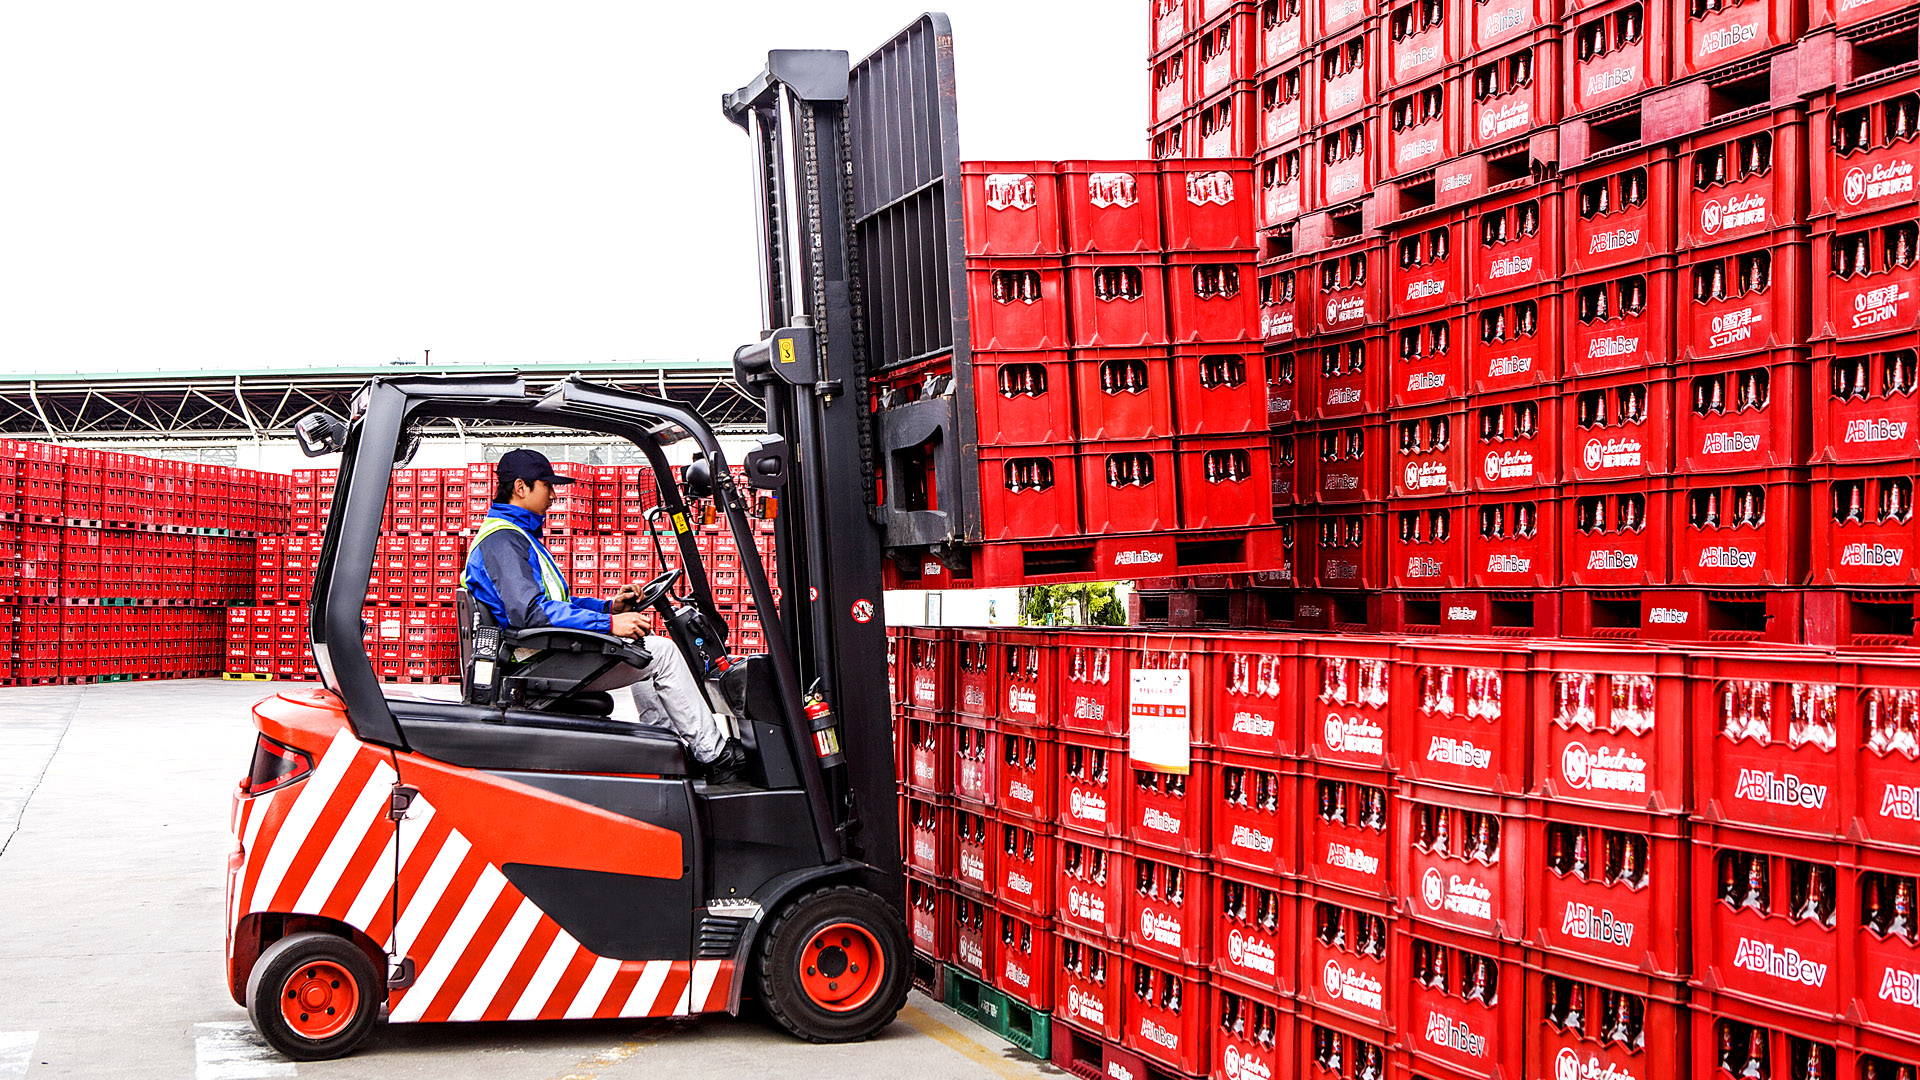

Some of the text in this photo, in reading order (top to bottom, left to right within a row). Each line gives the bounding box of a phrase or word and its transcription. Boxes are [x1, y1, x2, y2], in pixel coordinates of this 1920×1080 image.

[1485, 7, 1525, 39] ABInBev
[1700, 22, 1758, 57] ABInBev
[1399, 45, 1438, 73] ABInBev
[1586, 65, 1635, 96] ABInBev
[1496, 101, 1529, 121] Sedrin
[1399, 139, 1437, 163] ABInBev
[1440, 173, 1472, 192] ABInBev
[1866, 160, 1913, 183] Sedrin
[1722, 193, 1766, 215] Sedrin
[1589, 229, 1639, 254] ABInBev
[1490, 256, 1533, 279] ABInBev
[1407, 279, 1445, 300] ABInBev
[1867, 284, 1898, 310] 雪津
[1338, 297, 1365, 312] Sedrin
[1852, 303, 1897, 329] SEDRIN
[1723, 307, 1752, 331] 雪津
[1588, 335, 1638, 358] ABInBev
[1709, 325, 1751, 349] SEDRIN
[1488, 356, 1532, 377] ABInBev
[1408, 372, 1445, 391] ABInBev
[1327, 388, 1361, 405] ABInBev
[1703, 431, 1760, 454] ABInBev
[1845, 418, 1907, 443] ABInBev
[1603, 437, 1641, 454] Sedrin
[1419, 462, 1447, 476] Sedrin
[1499, 453, 1533, 466] Sedrin
[1115, 551, 1163, 565] ABInBev
[1488, 554, 1531, 573] ABInBev
[1587, 550, 1638, 569] ABInBev
[1699, 547, 1756, 568] ABInBev
[1841, 543, 1903, 567] ABInBev
[1407, 557, 1443, 578] ABInBev
[1448, 606, 1477, 621] ABInBev
[1649, 607, 1688, 624] ABInBev
[1074, 695, 1105, 721] ABInBev
[1232, 711, 1275, 737] ABInBev
[1344, 717, 1383, 739] Sedrin
[1427, 735, 1492, 770] ABInBev
[1590, 746, 1646, 773] Sedrin
[1009, 780, 1034, 804] ABInBev
[1081, 790, 1106, 810] Sedrin
[1735, 768, 1827, 809] ABInBev
[1143, 807, 1181, 834] ABInBev
[1231, 824, 1274, 853] ABInBev
[1327, 842, 1379, 875] ABInBev
[1008, 870, 1033, 895] ABInBev
[1449, 875, 1492, 902] Sedrin
[1154, 912, 1181, 933] Sedrin
[1561, 901, 1634, 948] ABInBev
[1243, 936, 1276, 960] Sedrin
[1006, 961, 1031, 989] ABInBev
[1733, 937, 1827, 989] ABInBev
[1343, 967, 1383, 994] Sedrin
[1079, 988, 1104, 1011] Sedrin
[1140, 1018, 1178, 1050] ABInBev
[1425, 1011, 1485, 1059] ABInBev
[1241, 1052, 1271, 1080] Sedrin
